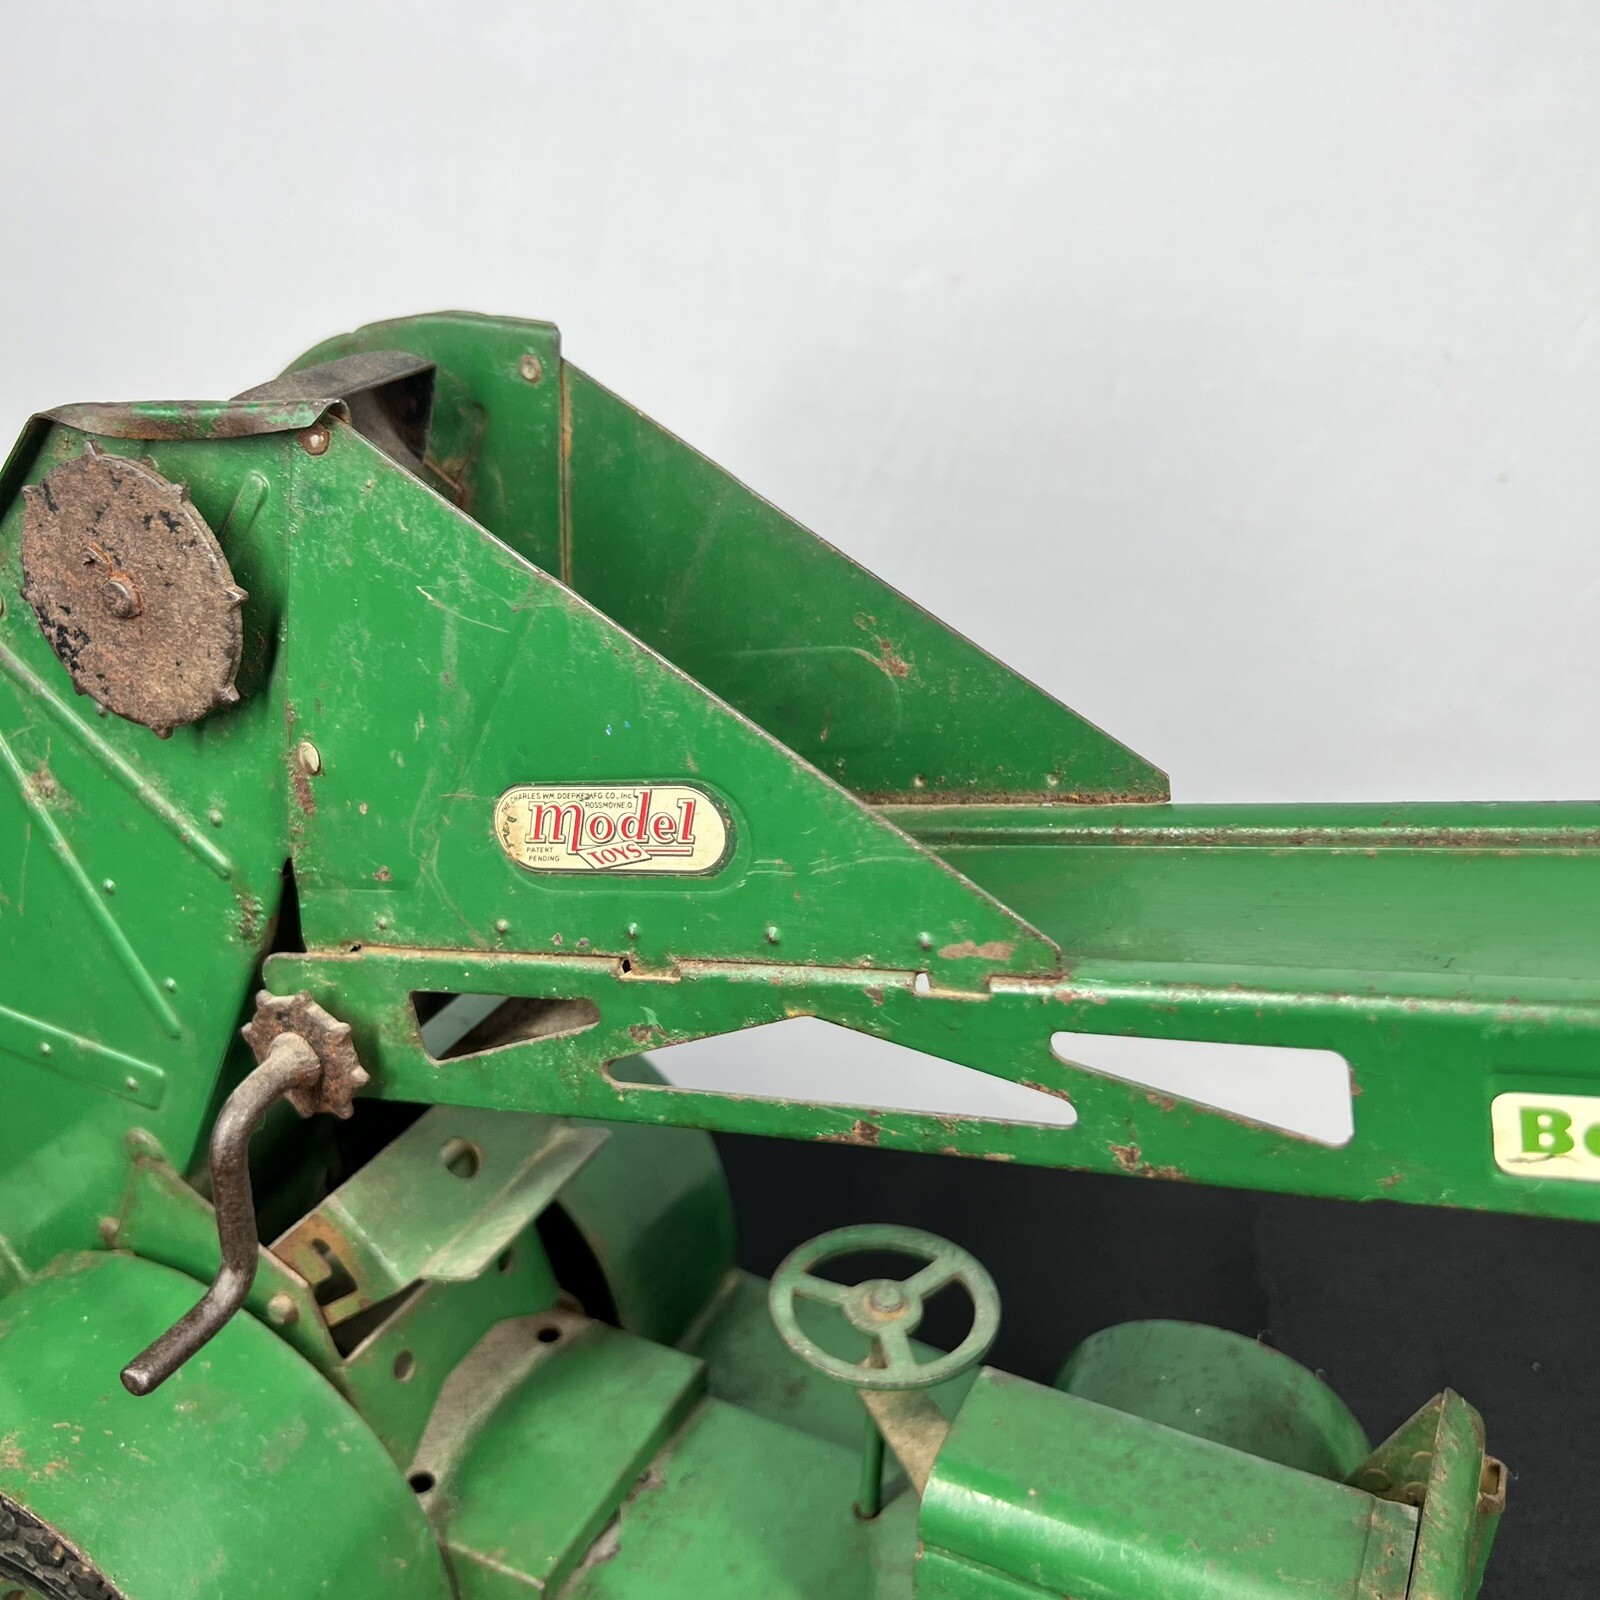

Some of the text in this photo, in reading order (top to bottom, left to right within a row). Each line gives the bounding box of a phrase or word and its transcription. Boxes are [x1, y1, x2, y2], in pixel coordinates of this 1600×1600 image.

[511, 792, 541, 804] CHARLES
[557, 792, 586, 800] DOEPKE
[587, 843, 643, 865] TOYS
